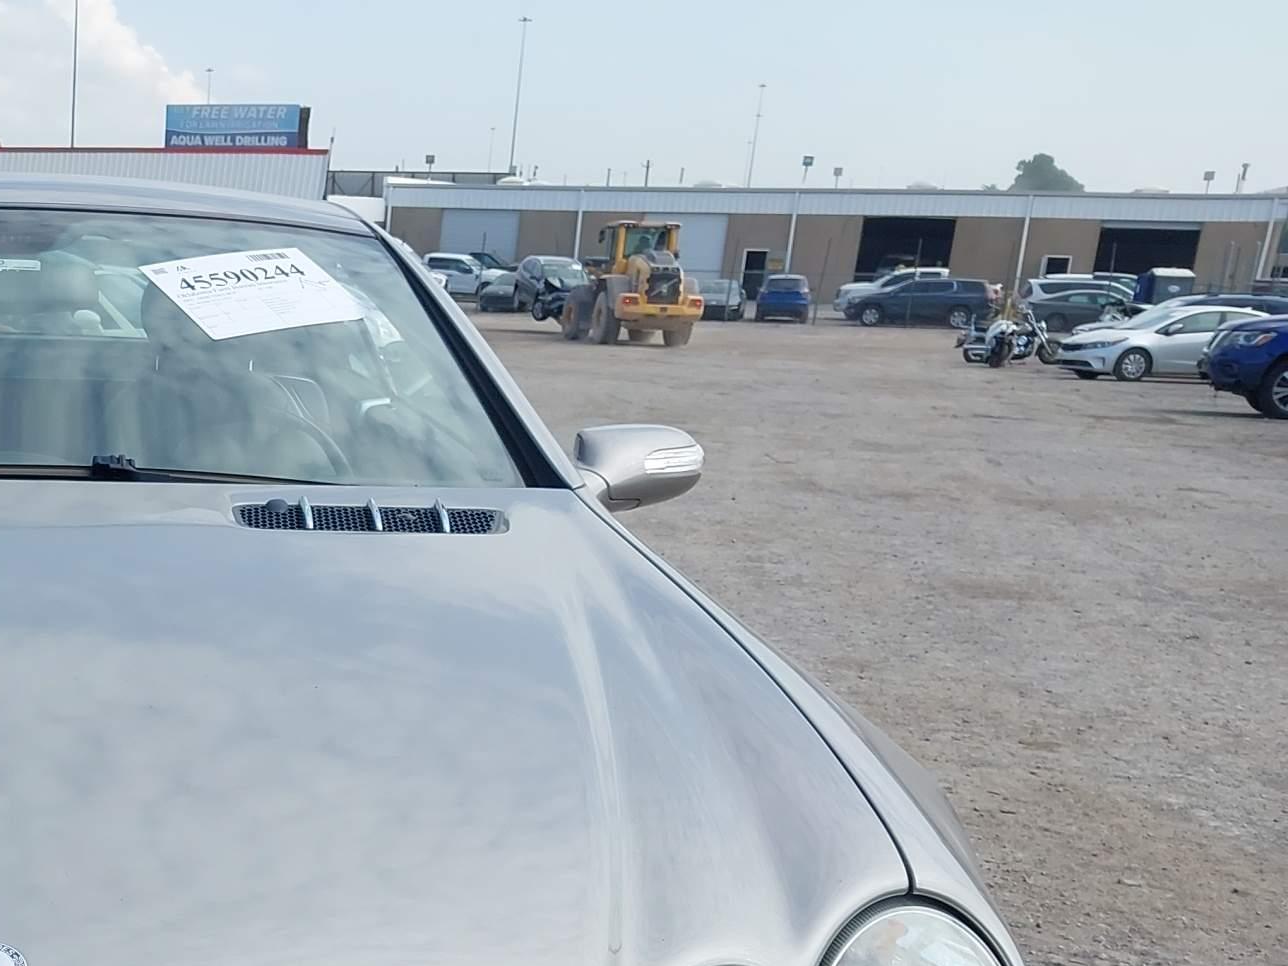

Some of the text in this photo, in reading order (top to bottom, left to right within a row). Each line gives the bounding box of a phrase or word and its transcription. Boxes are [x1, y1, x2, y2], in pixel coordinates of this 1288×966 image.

[192, 106, 229, 119] FREE
[232, 106, 287, 119] WATER
[170, 135, 288, 146] AQUA WELL DRILLING
[179, 263, 305, 291] 45590244
